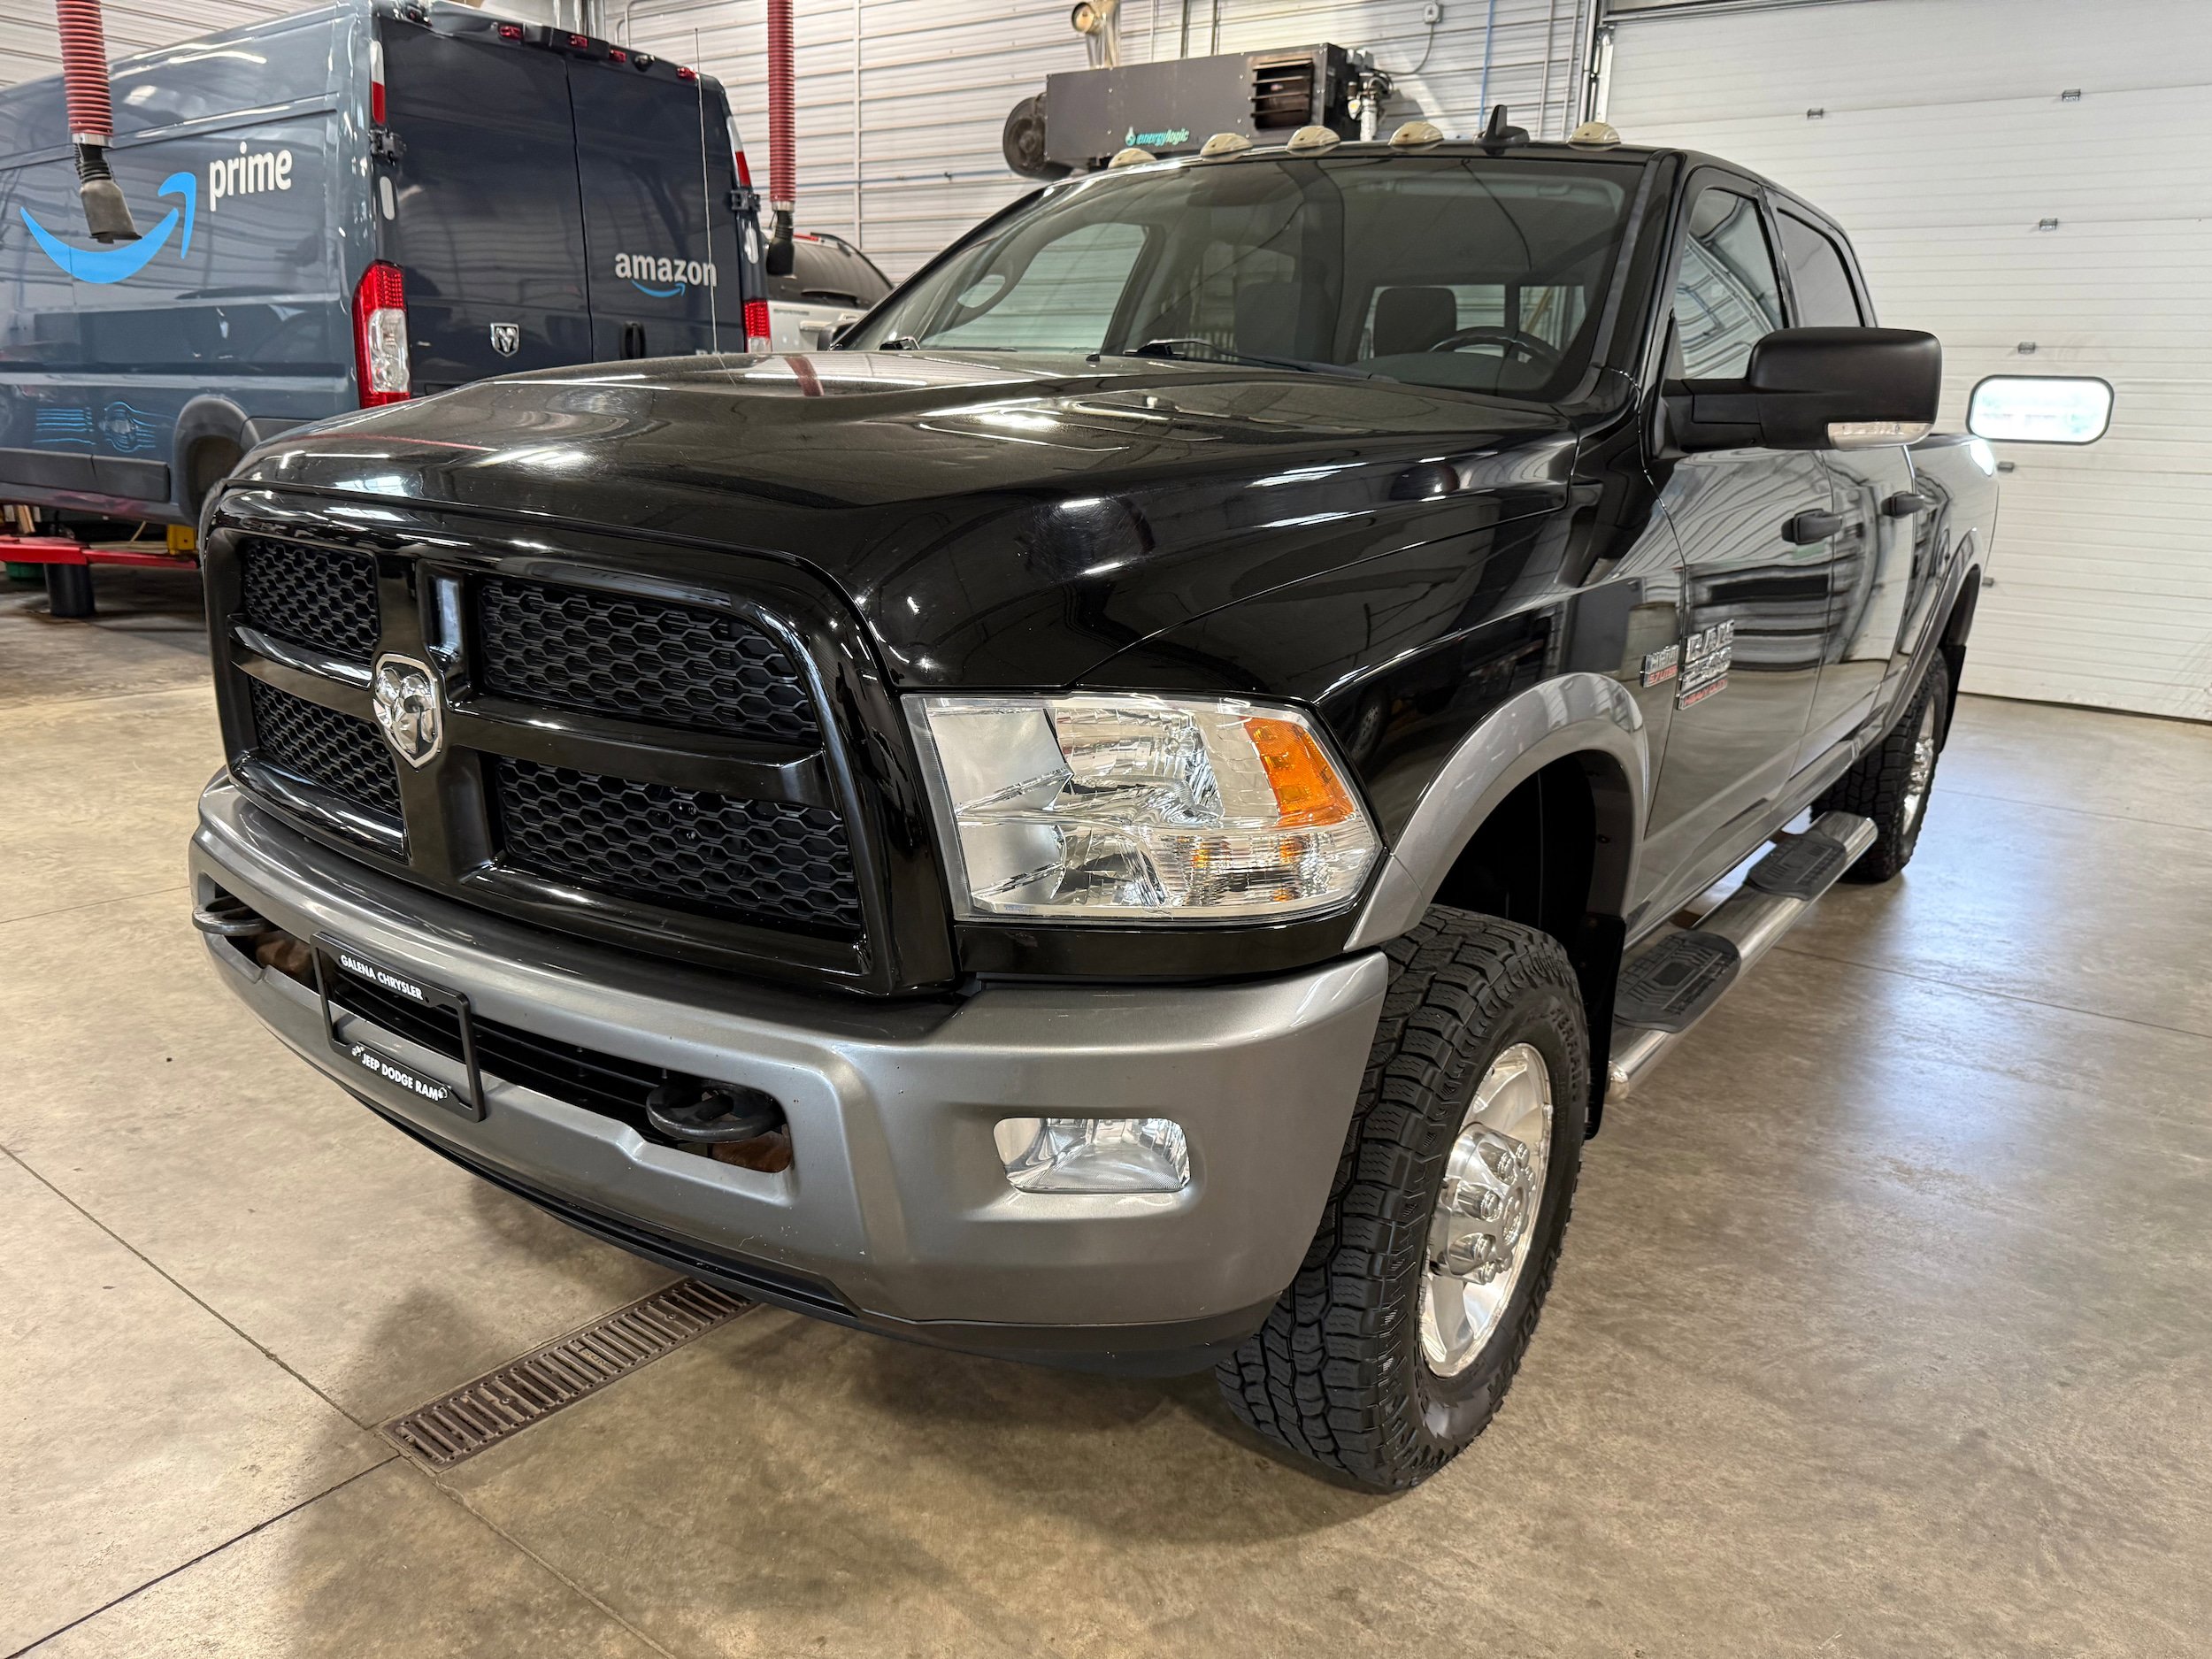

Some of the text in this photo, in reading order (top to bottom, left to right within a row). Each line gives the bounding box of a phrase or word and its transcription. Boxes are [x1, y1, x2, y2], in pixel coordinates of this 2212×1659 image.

[1136, 127, 1190, 147] energylogic
[209, 141, 293, 212] prime
[615, 253, 718, 287] amazon
[1685, 619, 1735, 664] RAM
[340, 954, 424, 1001] GALENA CHRYSLER
[361, 1053, 440, 1102] JEEP DODGE RAM
